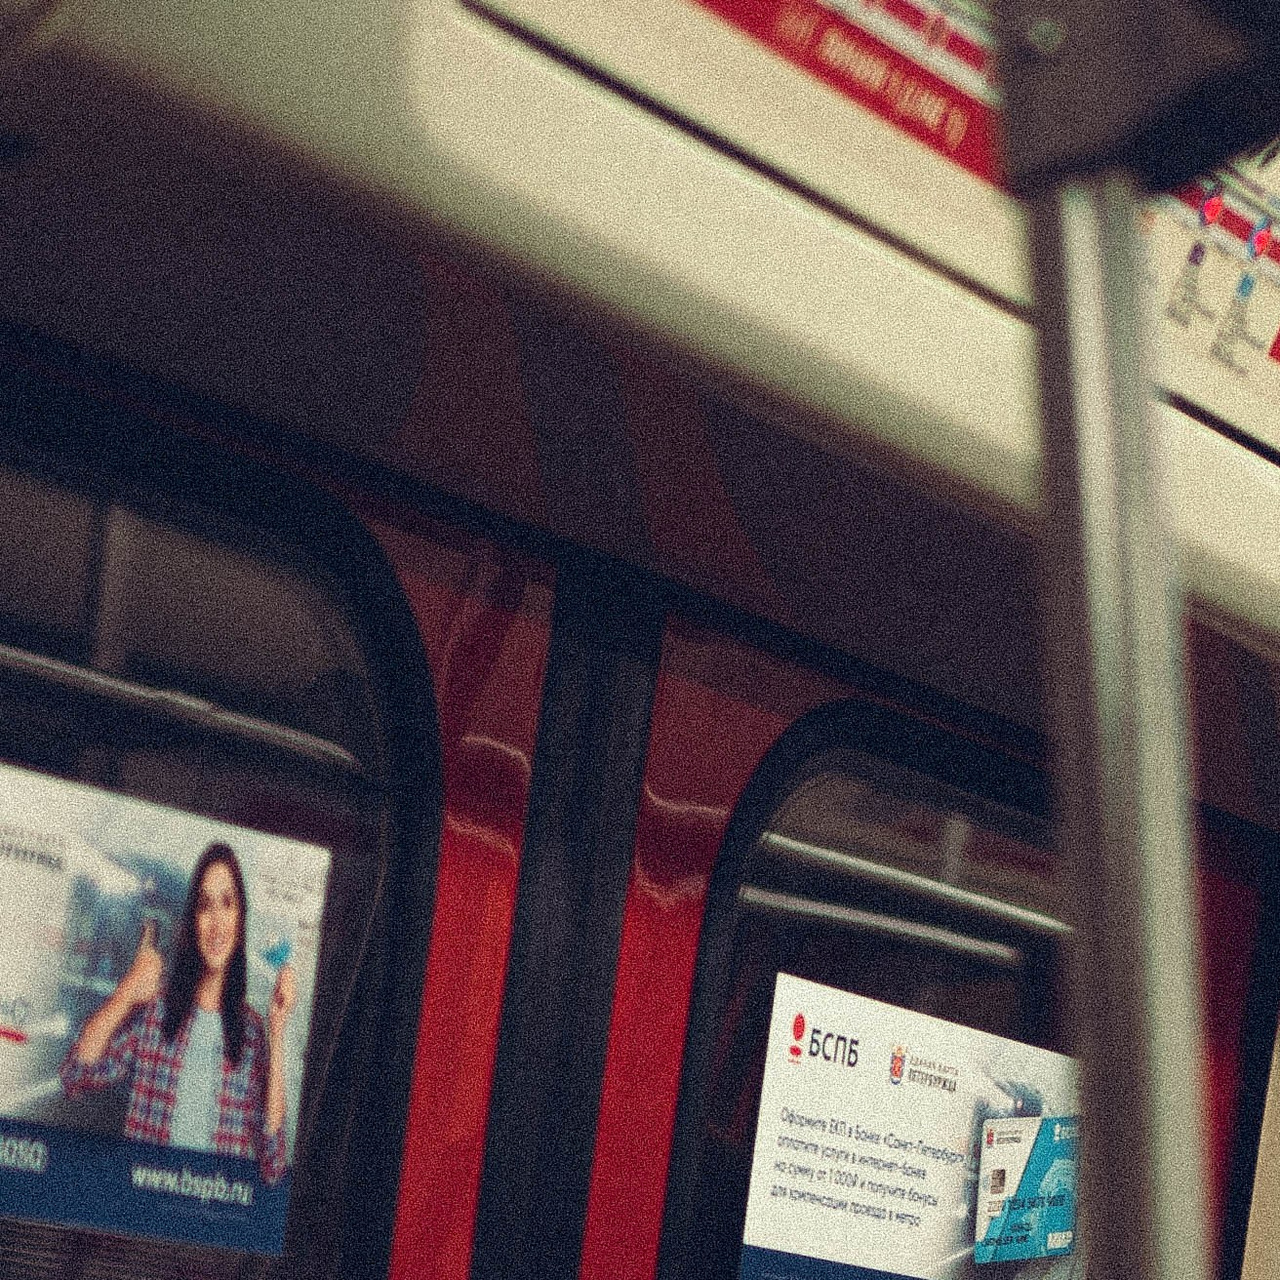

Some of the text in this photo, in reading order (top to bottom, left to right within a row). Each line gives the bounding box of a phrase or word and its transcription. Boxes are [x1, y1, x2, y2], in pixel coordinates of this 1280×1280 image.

[808, 1027, 860, 1068] БСПБ
[780, 1106, 826, 1132] Оформите
[132, 1164, 255, 1208] www.bspb.ru
